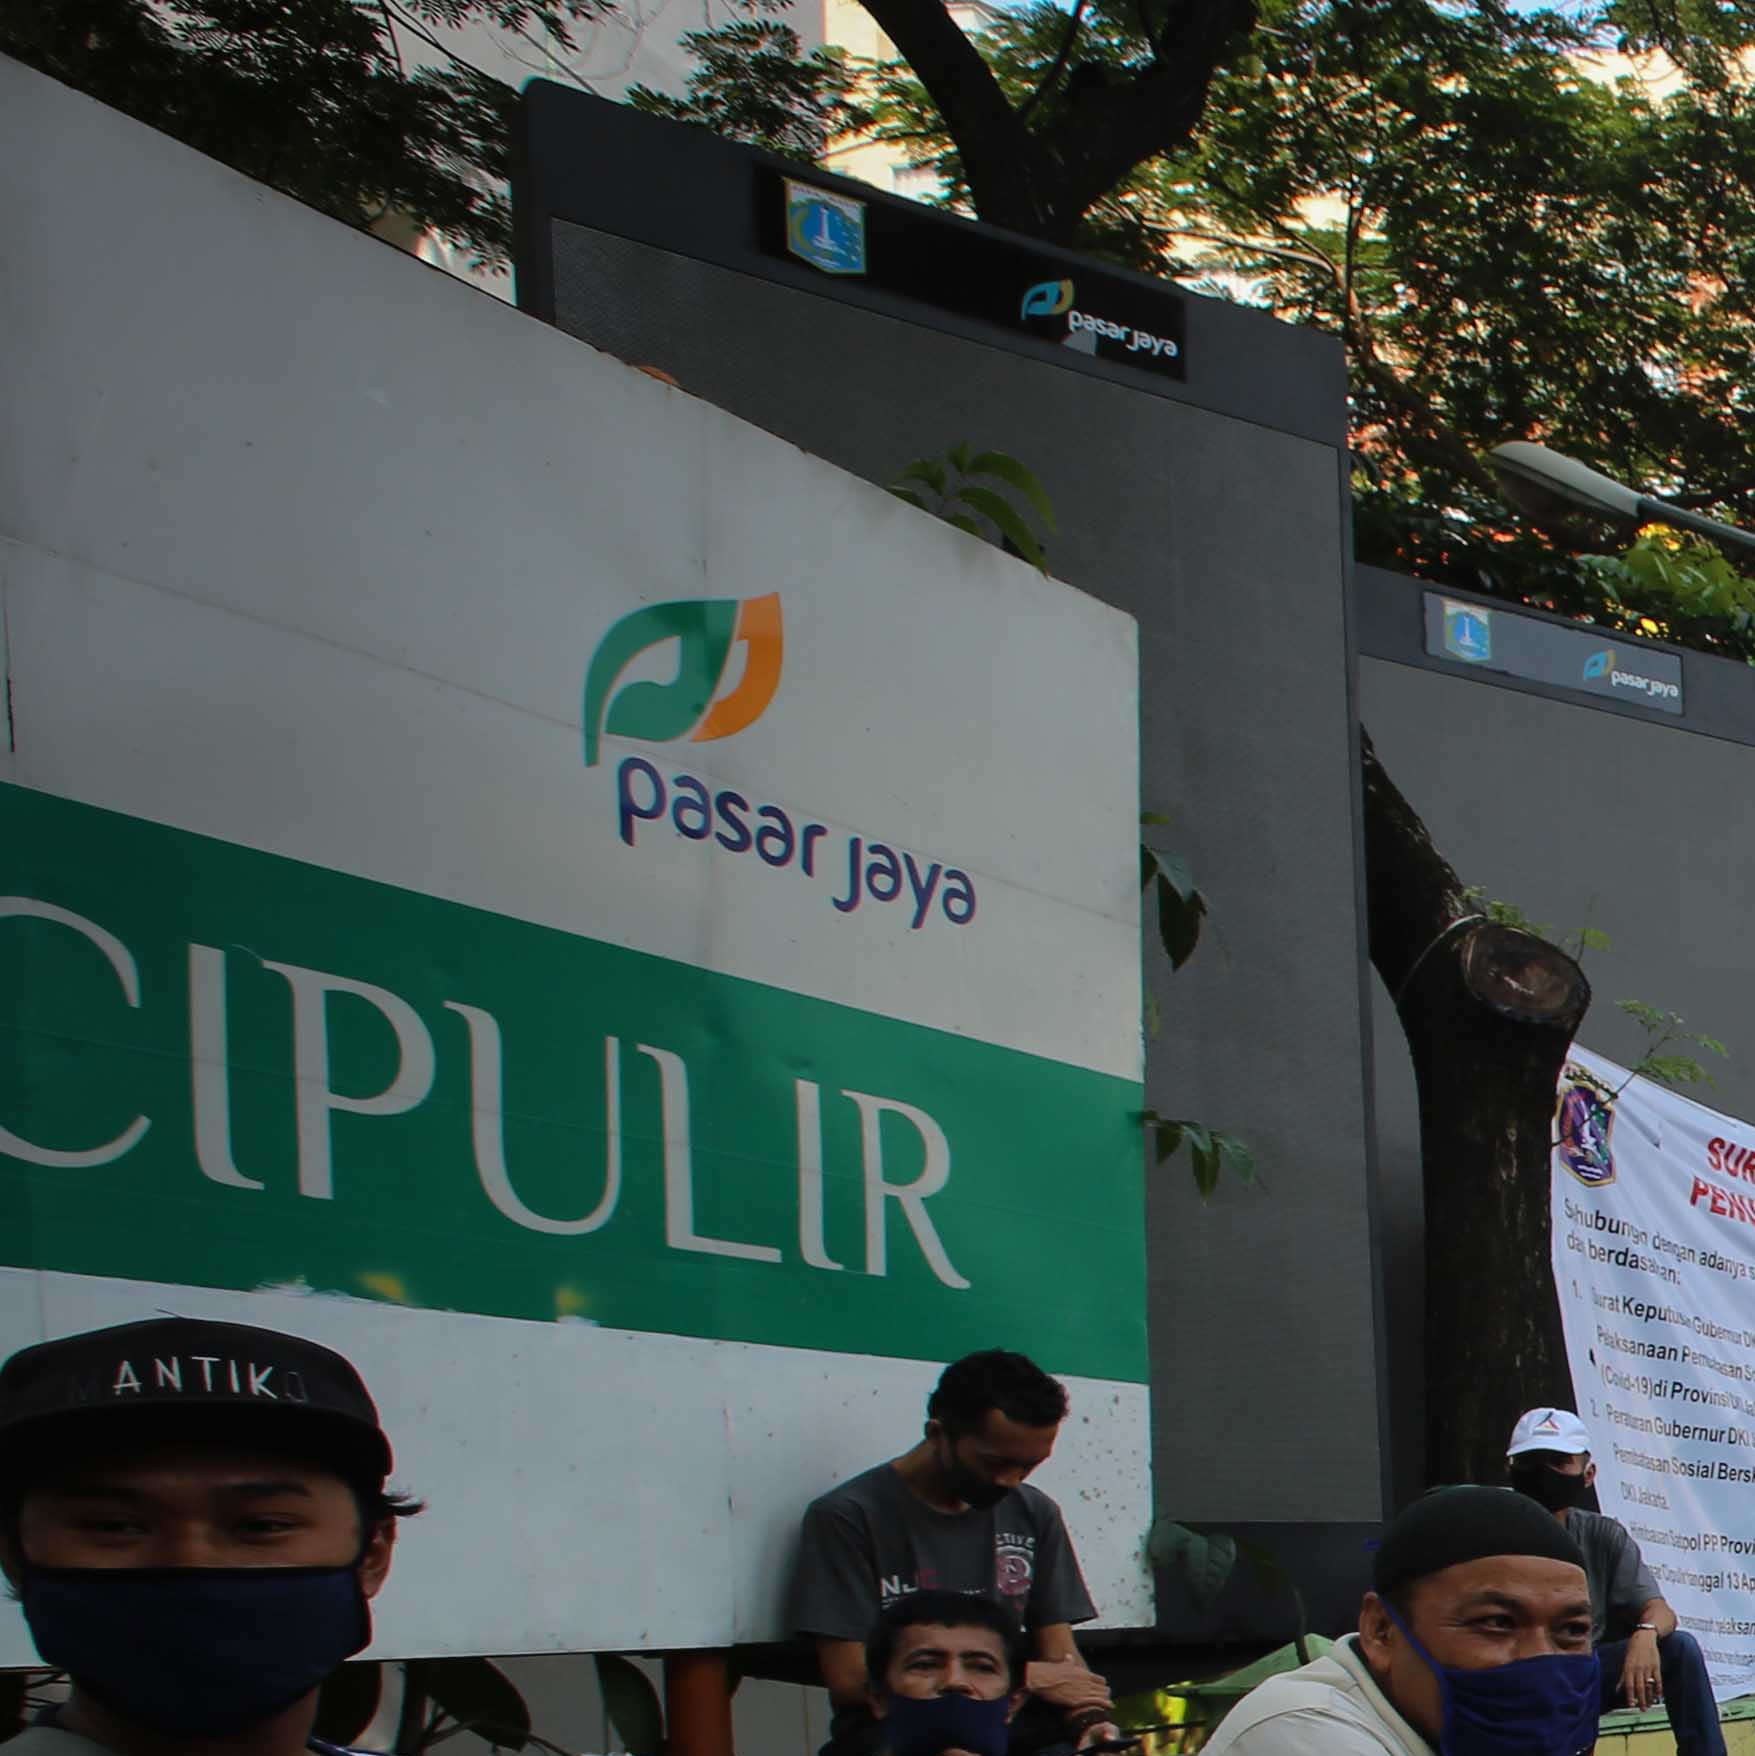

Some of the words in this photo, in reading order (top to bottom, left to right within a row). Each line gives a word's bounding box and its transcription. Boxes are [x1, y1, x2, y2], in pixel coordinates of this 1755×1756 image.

[1069, 308, 1130, 342] pasar
[1126, 331, 1178, 358] jaya
[1610, 670, 1649, 691] pasar
[1646, 680, 1680, 698] jaya
[616, 755, 828, 878] pasar
[832, 830, 978, 930] jaya
[0, 895, 972, 1290] CIPULIR
[1699, 1249, 1747, 1280] adanya
[1653, 1379, 1667, 1398] di
[1653, 1416, 1726, 1445] Gubernur
[1727, 1427, 1751, 1447] DKI
[1671, 1455, 1715, 1480] Sosial
[1703, 1534, 1719, 1550] PP
[1726, 1574, 1741, 1591] 13
